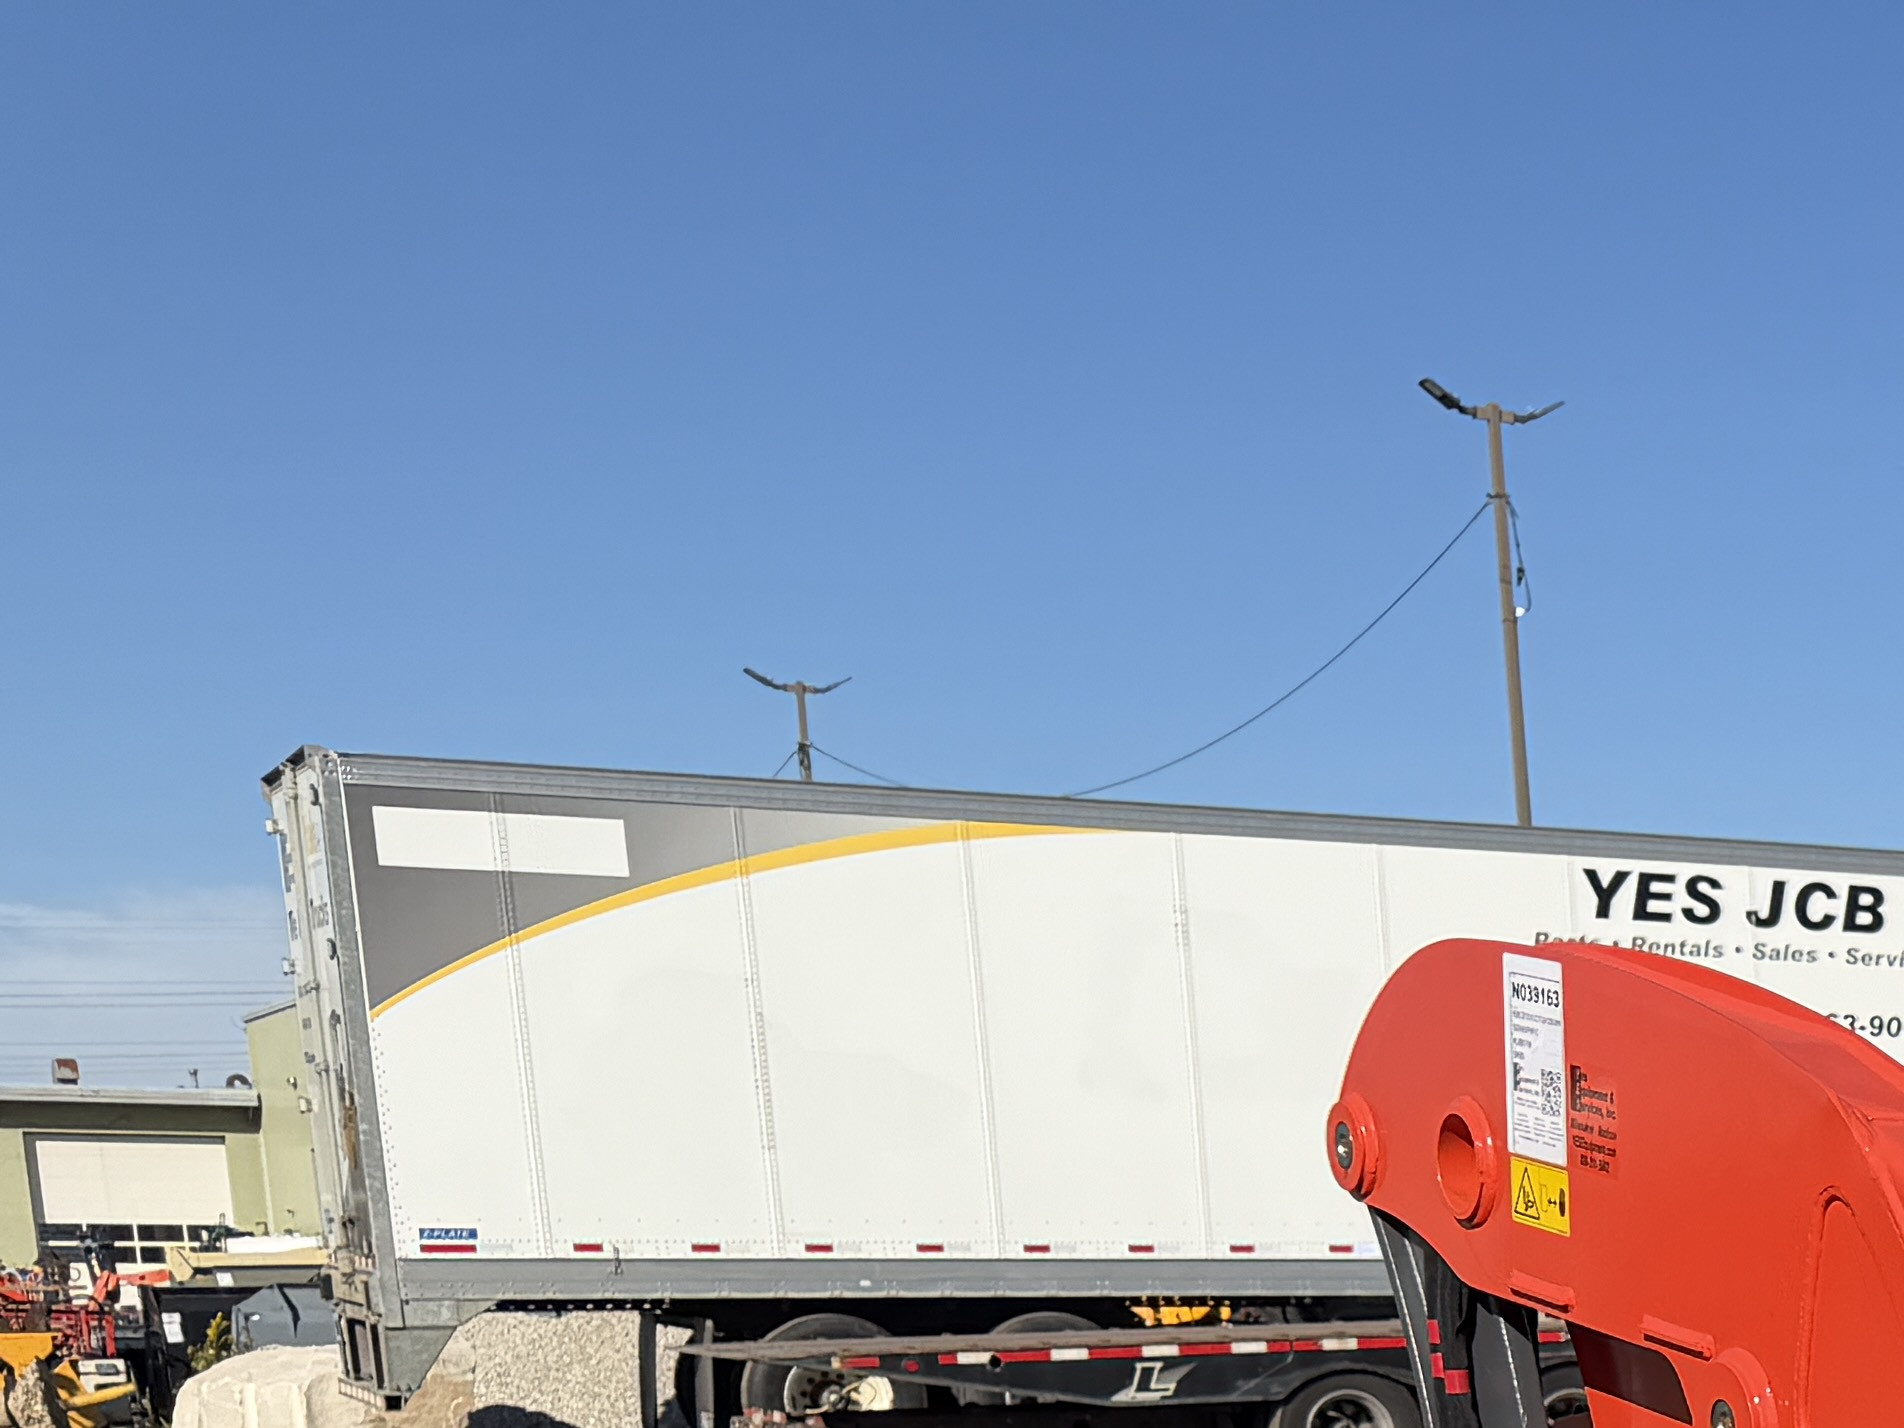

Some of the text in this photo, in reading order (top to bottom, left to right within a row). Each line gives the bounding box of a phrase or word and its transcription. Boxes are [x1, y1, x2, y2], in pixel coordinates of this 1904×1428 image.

[1583, 869, 1886, 934] YES JCB
[1631, 936, 1725, 959] Rentals
[1752, 942, 1818, 963] Sales
